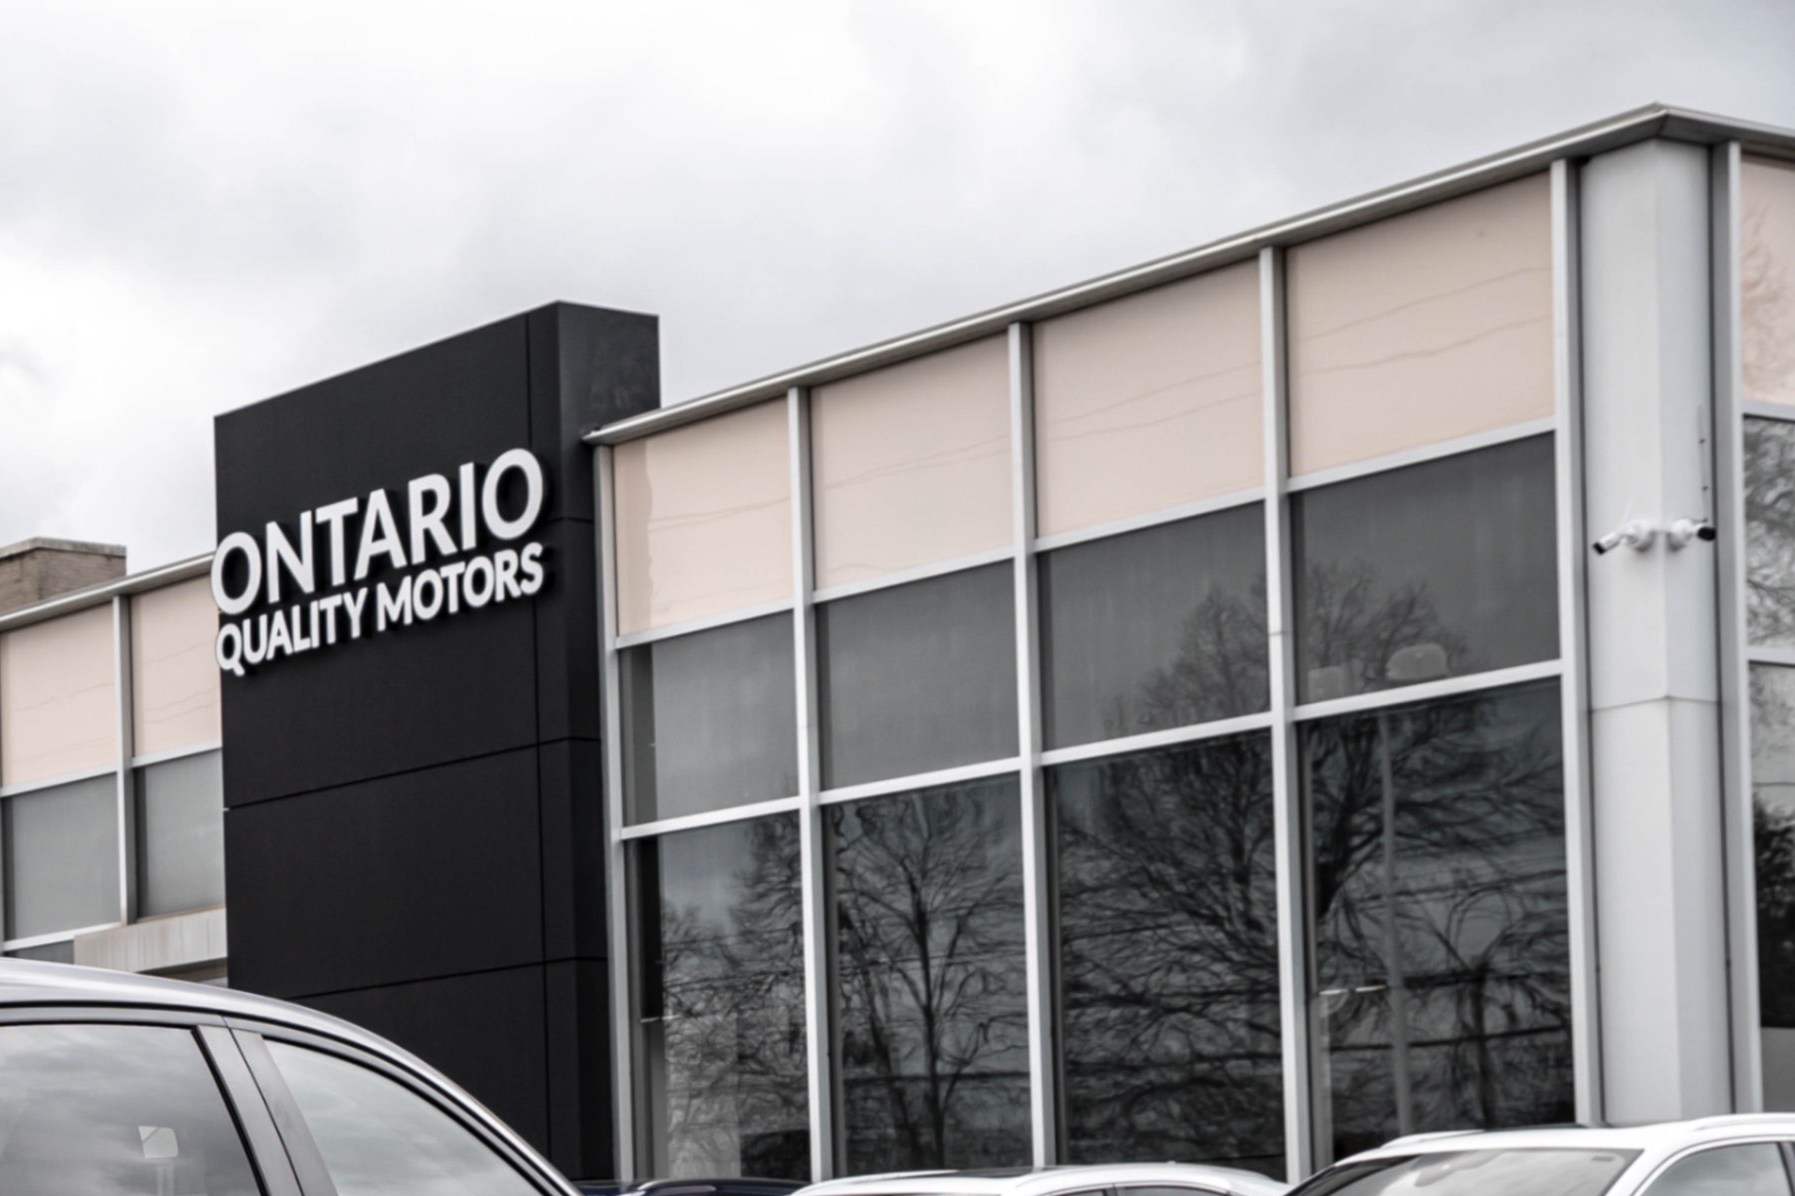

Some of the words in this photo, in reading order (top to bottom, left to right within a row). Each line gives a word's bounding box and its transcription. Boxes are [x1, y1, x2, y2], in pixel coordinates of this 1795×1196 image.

[210, 447, 545, 616] ONTARIO
[215, 587, 368, 677] QUALITY
[376, 541, 545, 632] MOTORS
